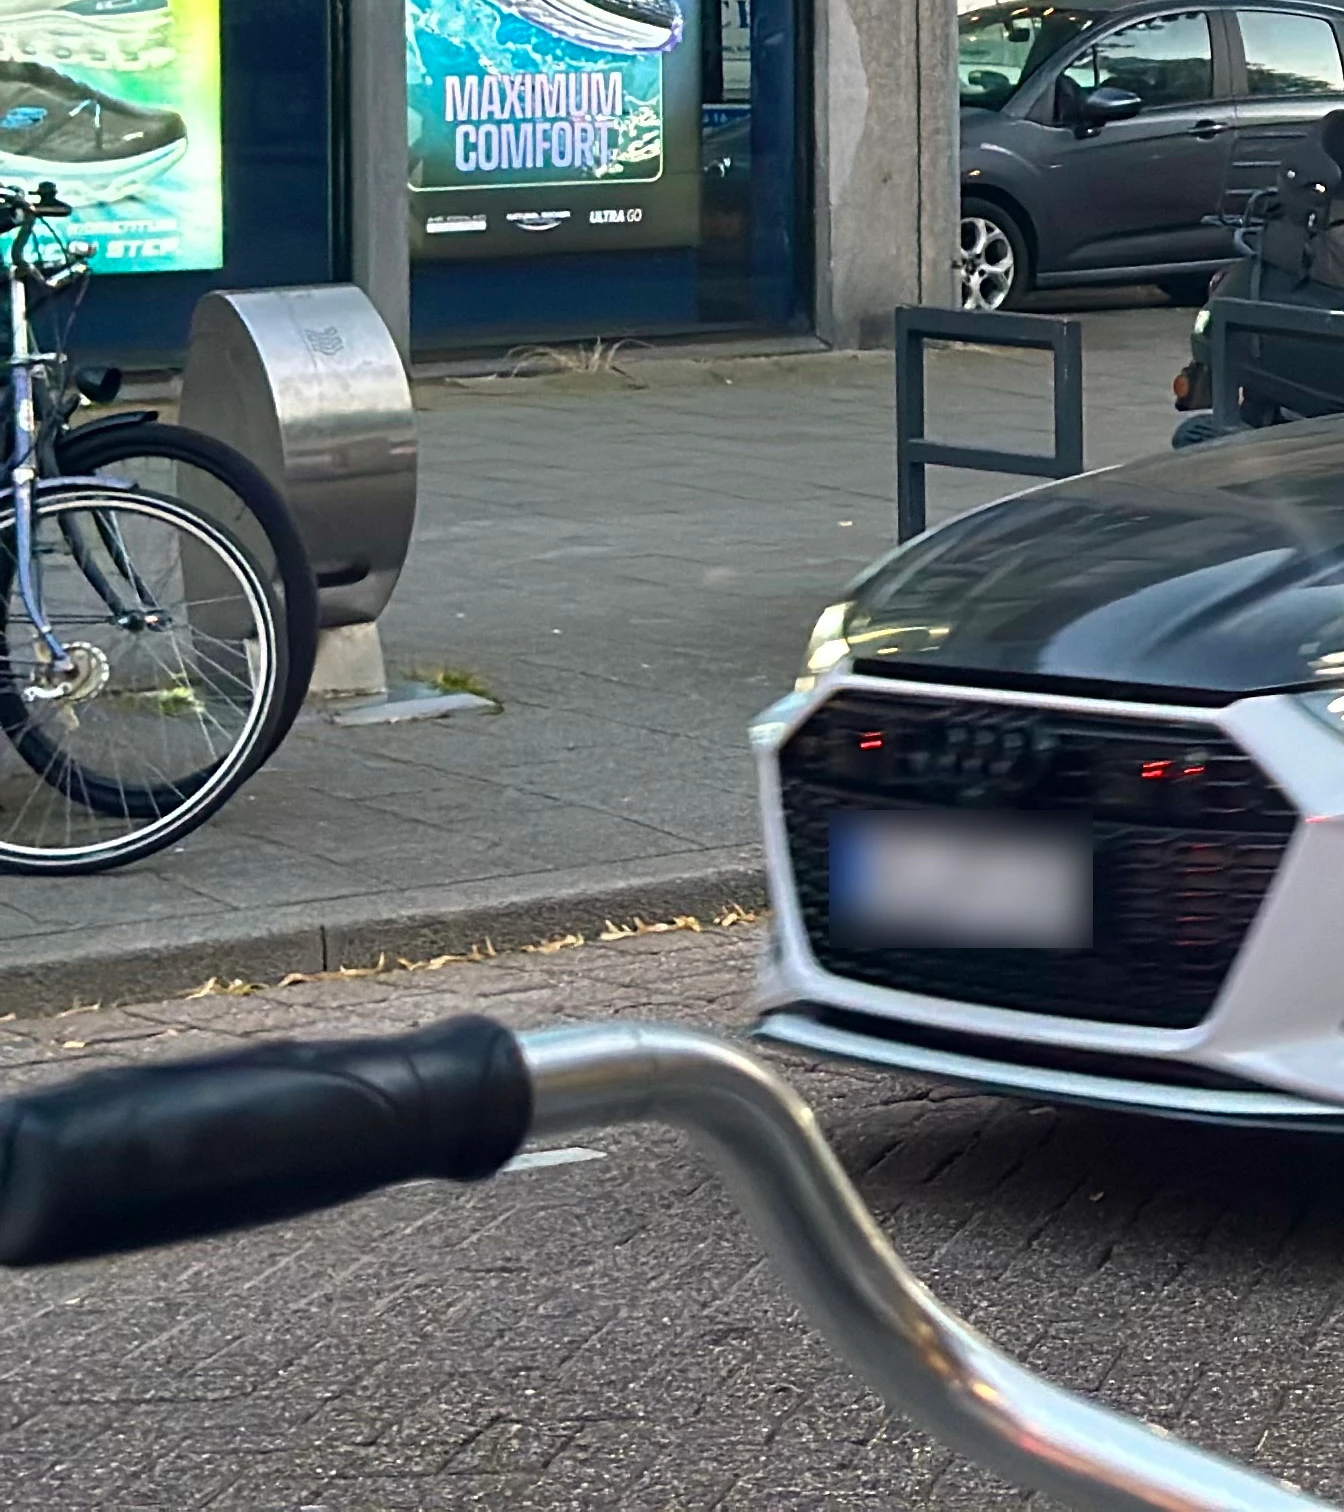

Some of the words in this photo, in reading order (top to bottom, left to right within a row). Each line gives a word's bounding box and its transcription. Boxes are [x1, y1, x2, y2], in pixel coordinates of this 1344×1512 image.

[444, 71, 623, 122] MAXIMUM
[455, 119, 614, 173] COMFORT
[588, 209, 624, 224] ULTRA
[626, 208, 643, 223] GO
